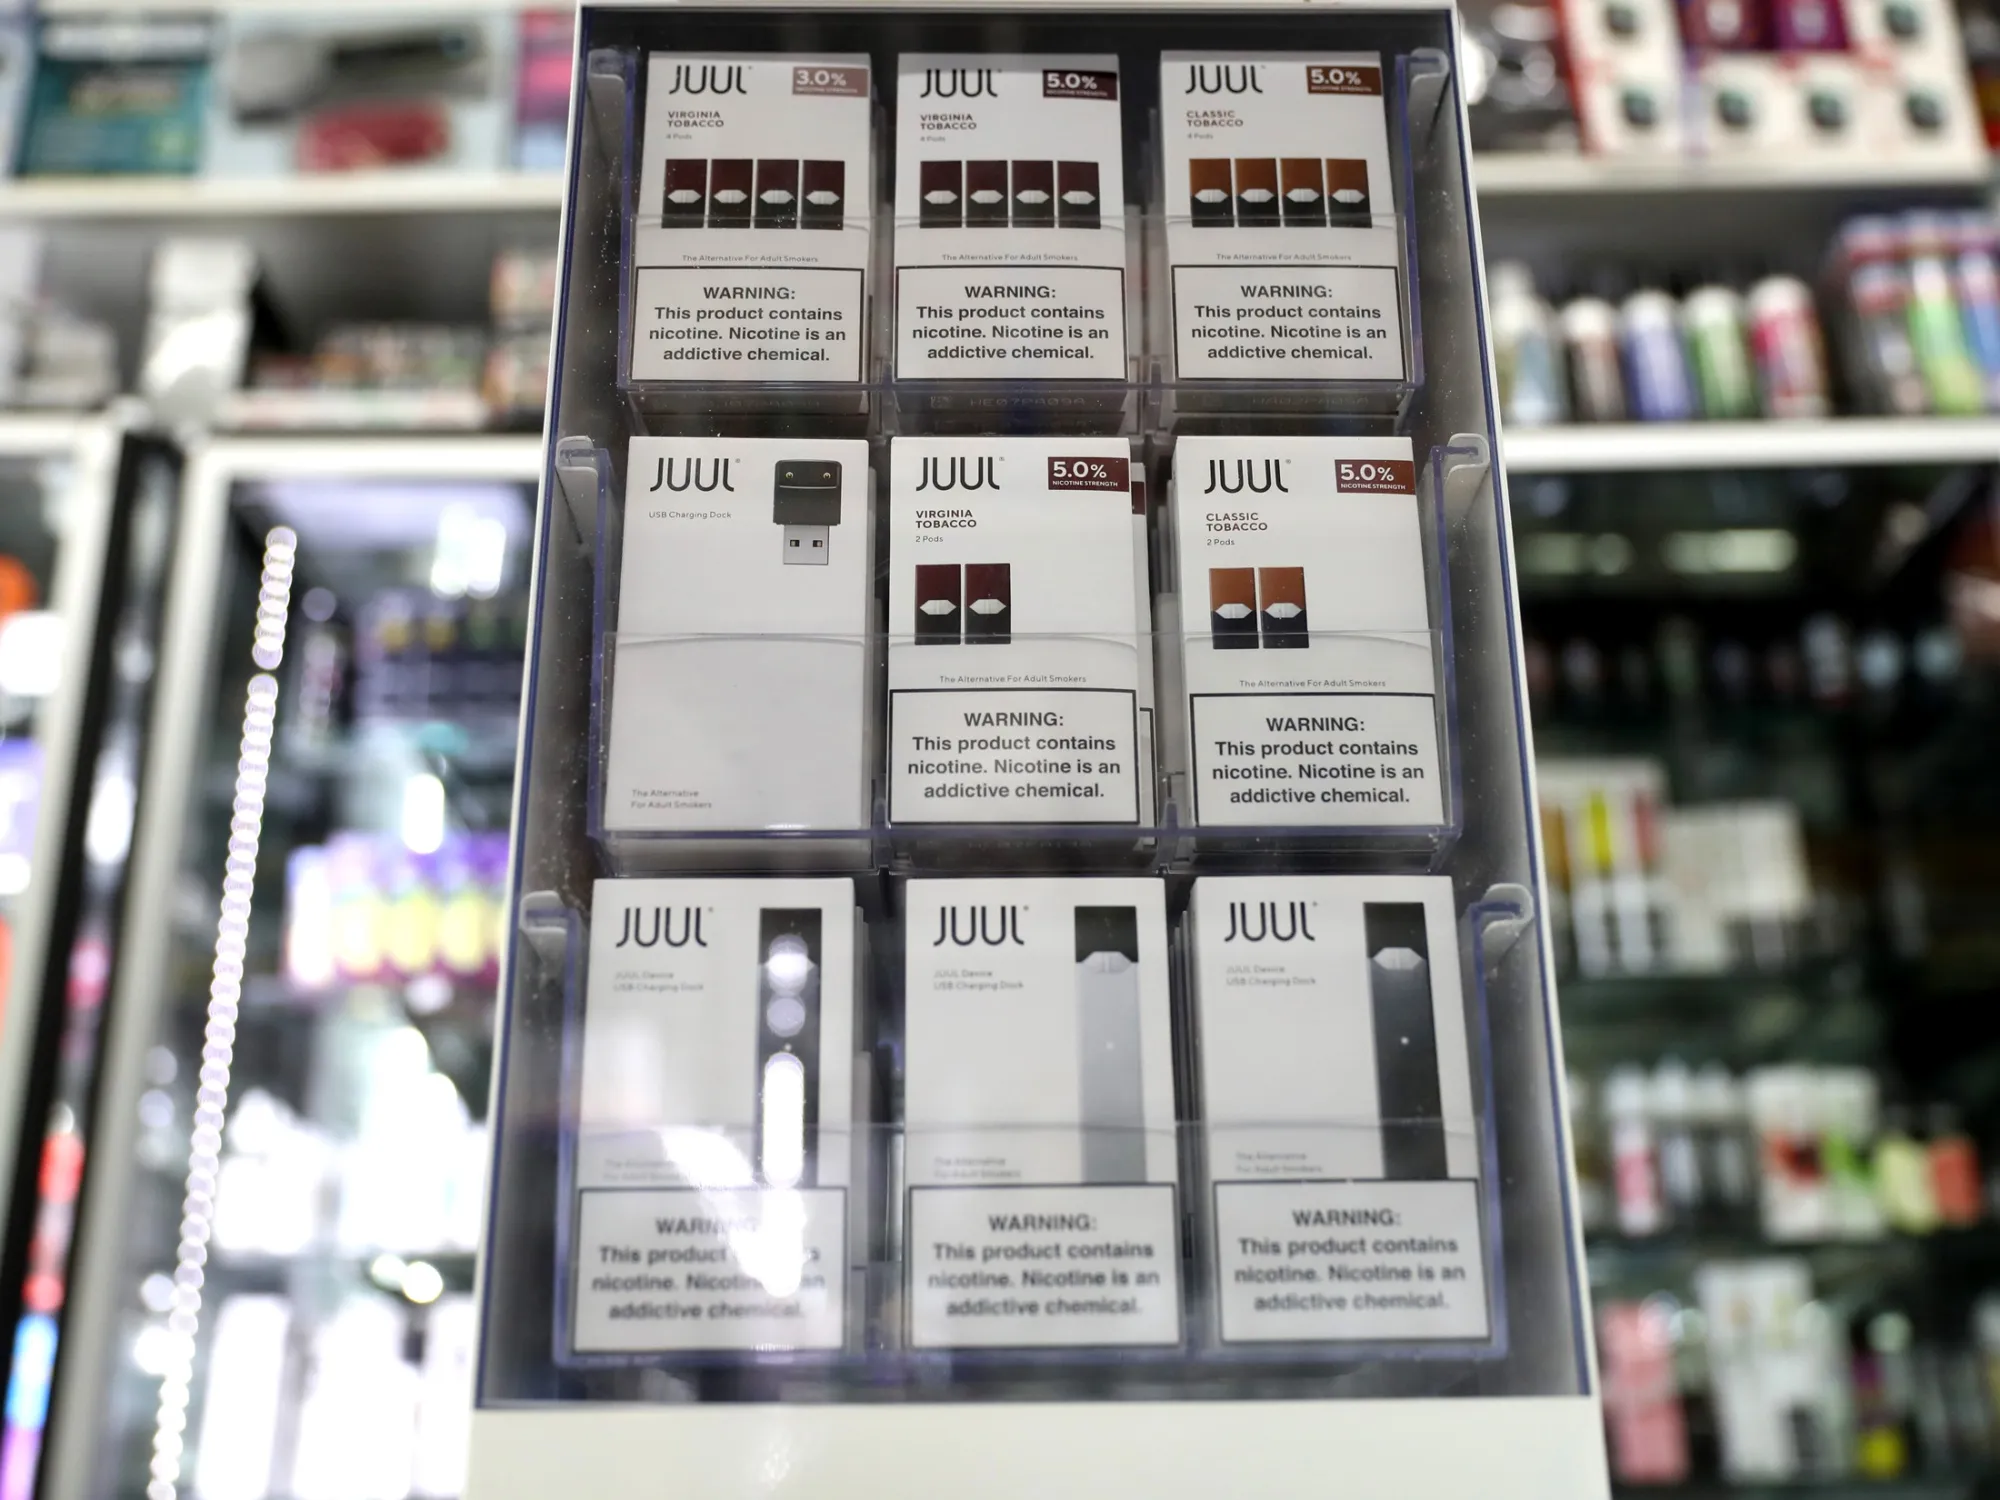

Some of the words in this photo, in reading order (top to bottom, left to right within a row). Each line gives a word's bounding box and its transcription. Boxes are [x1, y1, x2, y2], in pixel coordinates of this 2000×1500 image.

[668, 64, 748, 95] JUUL
[796, 69, 847, 87] 3.0%
[919, 68, 999, 98] JUUL
[1047, 72, 1098, 90] 5.0%
[1185, 64, 1264, 95] JUUL
[1311, 68, 1362, 85] 5.0%
[667, 118, 725, 127] TOBACCO
[919, 114, 974, 122] VIRGINIA
[1185, 110, 1235, 118] CLASSIC
[920, 122, 977, 130] TOBACCO
[1186, 119, 1244, 127] TOBACCO
[682, 254, 698, 262] The
[698, 254, 744, 263] Alternative
[744, 254, 759, 262] For
[759, 255, 783, 263] Adult
[783, 255, 819, 263] Smokers
[941, 253, 958, 261] The
[958, 253, 1004, 261] Alternative
[1004, 253, 1019, 261] For
[1019, 253, 1042, 261] Adult
[1043, 253, 1079, 262] Smokers
[1215, 253, 1232, 261] The
[1232, 253, 1278, 261] Alternative
[1278, 253, 1293, 261] For
[1293, 253, 1316, 261] Adult
[1316, 253, 1352, 261] Smokers
[703, 286, 796, 300] WARNING:
[964, 285, 1056, 299] WARNING:
[1240, 285, 1333, 299] WARNING:
[653, 306, 691, 320] This
[696, 306, 764, 323] product
[768, 307, 843, 321] contains
[915, 305, 954, 319] This
[958, 305, 1026, 322] product
[1030, 305, 1105, 320] contains
[1193, 305, 1231, 319] This
[1236, 305, 1304, 321] product
[1307, 305, 1382, 319] contains
[649, 326, 723, 340] nicotine.
[729, 326, 801, 341] Nicotine
[805, 327, 820, 341] is
[825, 330, 846, 341] an
[912, 325, 987, 339] nicotine.
[991, 325, 1064, 339] Nicotine
[1068, 325, 1083, 339] is
[1087, 328, 1109, 339] an
[1191, 325, 1265, 339] nicotine.
[1270, 325, 1342, 339] Nicotine
[1346, 325, 1361, 339] is
[1365, 328, 1387, 339] an
[663, 347, 743, 361] addictive
[747, 347, 830, 362] chemical.
[927, 345, 1007, 359] addictive
[1011, 345, 1094, 359] chemical.
[1207, 345, 1287, 359] addictive
[1290, 345, 1373, 359] chemical.
[649, 457, 735, 493] JUUL
[915, 456, 1001, 492] JUUL
[1053, 460, 1107, 479] 5.0%
[1203, 458, 1290, 495] JUUL
[1340, 463, 1395, 482] 5.0%
[1052, 479, 1084, 487] NICOTINE
[648, 511, 668, 519] USB
[668, 511, 708, 520] Charging
[709, 511, 732, 519] Dock
[915, 510, 973, 518] VIRGINIA
[1205, 512, 1259, 520] CLASSIC
[915, 520, 977, 528] TOBACCO
[1205, 521, 1269, 531] TOBACCO
[922, 535, 944, 543] Pods
[1213, 538, 1235, 546] Pods
[939, 675, 956, 683] The
[957, 675, 1006, 683] Alternative
[1006, 674, 1022, 683] For
[1023, 674, 1048, 683] Adult
[1048, 674, 1087, 683] Smokers
[1239, 679, 1257, 688] The
[1257, 679, 1306, 688] Alternative
[1306, 679, 1323, 688] For
[1323, 679, 1348, 687] Adult
[1348, 679, 1387, 687] Smokers
[963, 711, 1064, 727] WARNING:
[1265, 716, 1365, 733] WARNING:
[911, 735, 952, 751] This
[957, 735, 1031, 755] product
[1035, 735, 1117, 751] contains
[1214, 740, 1256, 757] This
[1261, 740, 1335, 760] product
[1338, 740, 1419, 756] contains
[907, 759, 988, 775] nicotine.
[994, 758, 1072, 774] Nicotine
[1076, 758, 1093, 774] is
[1097, 762, 1121, 775] an
[1212, 763, 1293, 780] nicotine.
[1298, 763, 1376, 779] Nicotine
[1380, 763, 1397, 779] is
[1401, 767, 1425, 779] an
[631, 789, 649, 798] The
[649, 789, 700, 798] Alternative
[923, 782, 1010, 799] addictive
[1014, 781, 1105, 798] chemical.
[1229, 787, 1317, 804] addictive
[1320, 787, 1410, 803] chemical.
[630, 800, 647, 810] For
[647, 800, 673, 809] Adult
[673, 800, 713, 809] Smokers
[615, 906, 708, 949] JUUL
[933, 905, 1025, 947] JUUL
[1223, 901, 1317, 943] JUUL
[988, 1213, 1097, 1232] WARNING:
[1291, 1207, 1401, 1227] WARNING:
[933, 1242, 977, 1261] This
[981, 1242, 1062, 1265] product
[1066, 1241, 1155, 1260] contains
[1237, 1237, 1283, 1257] This
[1287, 1237, 1367, 1259] product
[1371, 1235, 1459, 1255] contains
[599, 1245, 642, 1265] This
[646, 1245, 727, 1268] product
[927, 1271, 1016, 1289] nicotine.
[1021, 1269, 1107, 1288] Nicotine
[1111, 1268, 1130, 1287] is
[1134, 1270, 1161, 1287] an
[1233, 1265, 1321, 1285] nicotine.
[1327, 1263, 1413, 1283] Nicotine
[1417, 1264, 1436, 1282] is
[1440, 1266, 1467, 1281] an
[591, 1274, 679, 1293] nicotine.
[685, 1273, 772, 1292] Nicotin
[945, 1299, 1041, 1318] addictive
[1043, 1297, 1144, 1316] chemical.
[1253, 1293, 1348, 1312] addictive
[1351, 1291, 1451, 1311] chemical.
[607, 1301, 704, 1321] addictive
